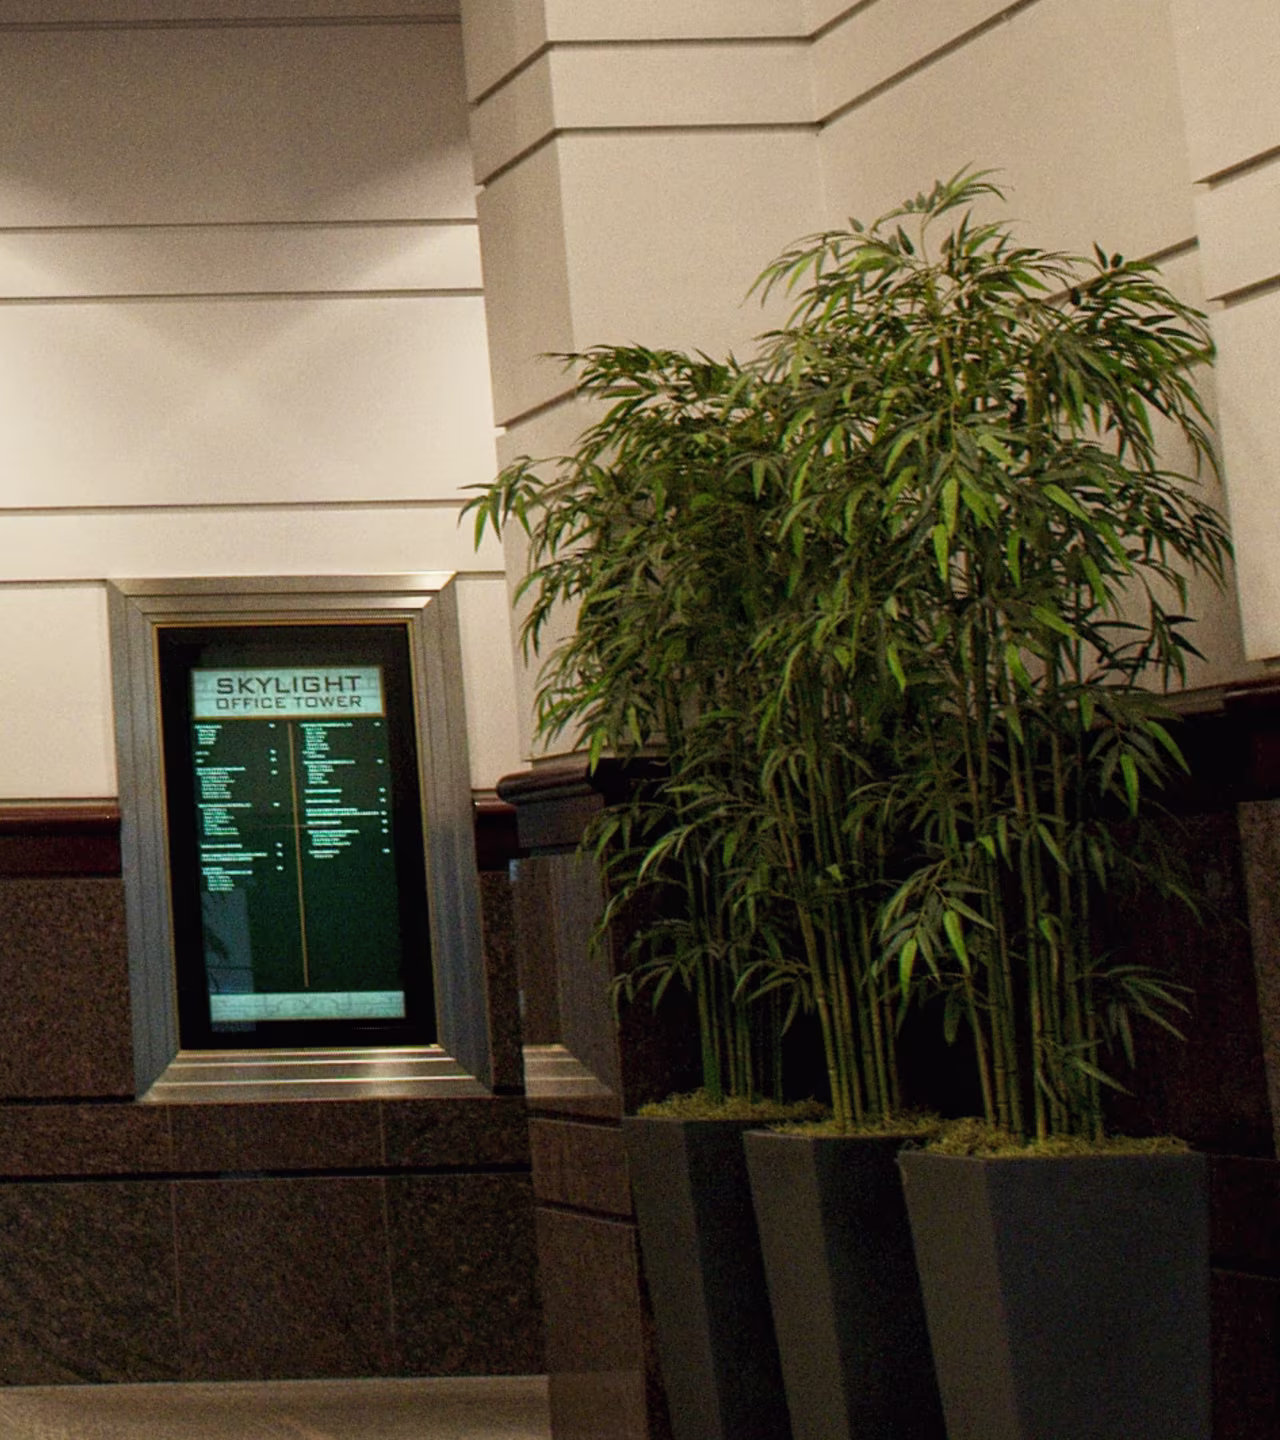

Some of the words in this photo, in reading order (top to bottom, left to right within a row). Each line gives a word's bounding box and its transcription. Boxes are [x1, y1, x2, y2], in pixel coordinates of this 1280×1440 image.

[216, 675, 362, 695] SKYLIGHT
[216, 696, 287, 710] OFFICE
[294, 695, 362, 708] TOWER
